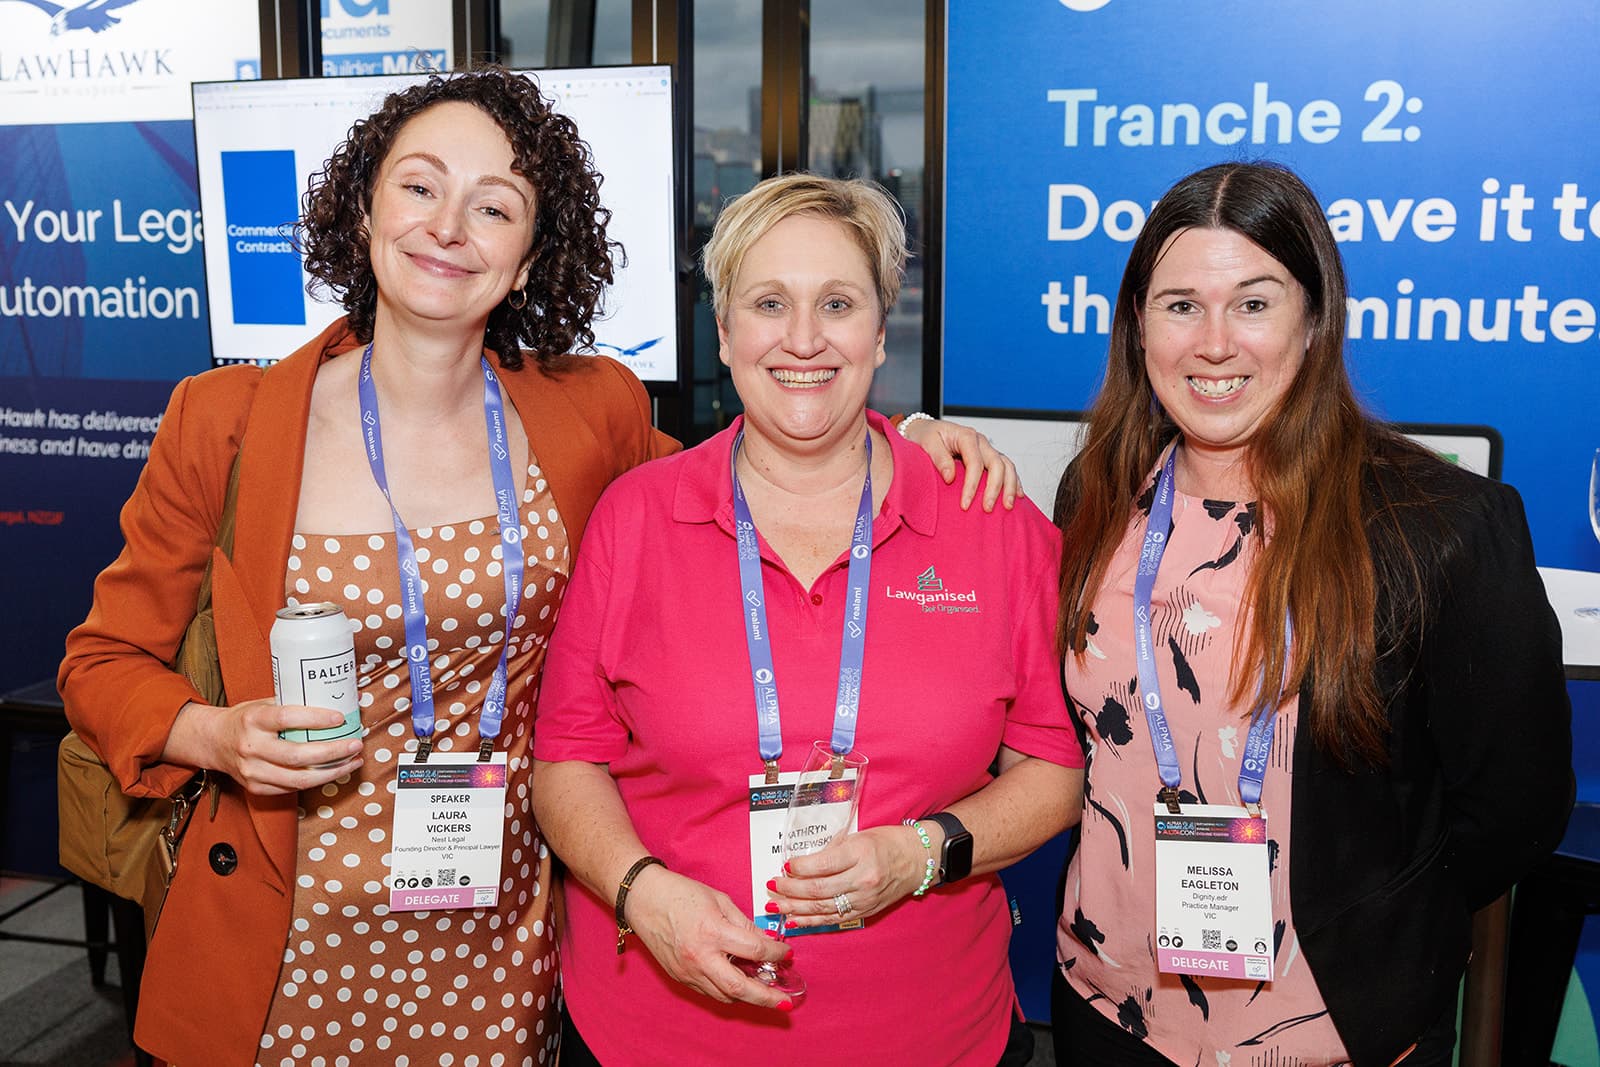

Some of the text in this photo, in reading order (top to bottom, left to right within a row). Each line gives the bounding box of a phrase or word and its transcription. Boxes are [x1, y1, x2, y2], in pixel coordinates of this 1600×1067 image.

[321, 23, 390, 39] cuments
[1047, 80, 1423, 147] Tranche 2:
[1048, 178, 1600, 243] Do ave it t
[5, 200, 102, 243] Your
[228, 224, 297, 237] Commercia
[236, 241, 293, 253] Contracts
[0, 276, 200, 320] utomation
[1041, 276, 1600, 344] th minute
[48, 409, 80, 429] has
[82, 411, 164, 433] delivered
[0, 434, 38, 454] ness
[40, 437, 76, 456] and
[77, 437, 121, 458] have
[498, 488, 511, 523] ALPMA
[854, 514, 865, 542] ALPMA
[886, 585, 977, 605] Lawganised
[308, 660, 354, 680] BALTER
[419, 665, 432, 703] ALPMA
[765, 687, 778, 725] ALPMA
[1155, 713, 1172, 751] ALPMA
[430, 795, 471, 804] SPEAKER
[432, 811, 468, 820] LAURA
[426, 824, 472, 833] VICKERS
[448, 835, 466, 844] Legal
[453, 844, 479, 852] Principal
[1187, 866, 1234, 876] MELISSA
[1181, 879, 1239, 890] EAGLETON
[405, 894, 460, 906] DELEGATE
[1182, 901, 1240, 912] Practice Manager
[1171, 956, 1230, 971] DELEGATE
